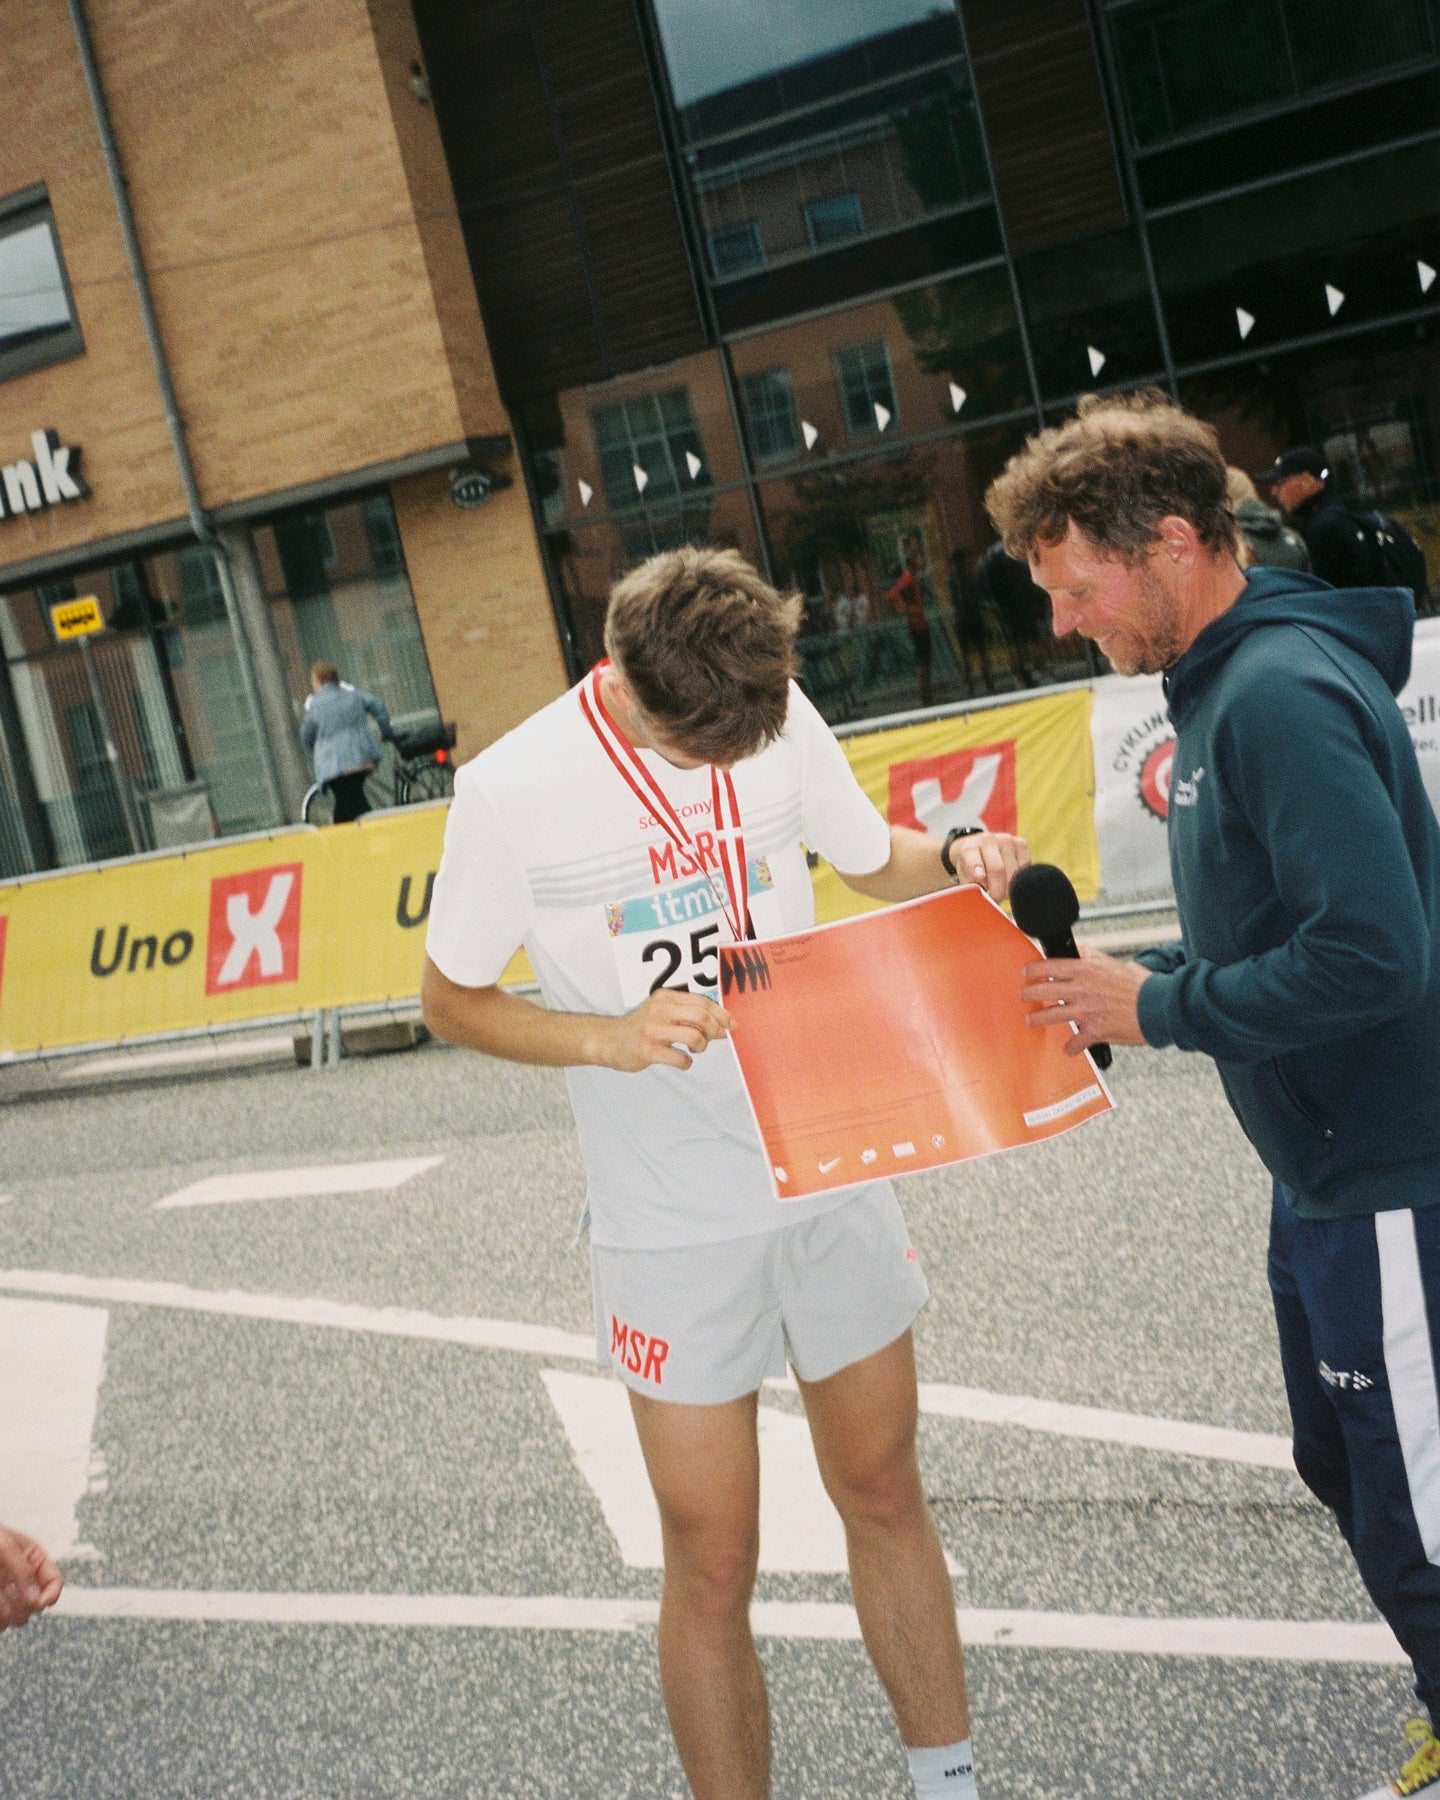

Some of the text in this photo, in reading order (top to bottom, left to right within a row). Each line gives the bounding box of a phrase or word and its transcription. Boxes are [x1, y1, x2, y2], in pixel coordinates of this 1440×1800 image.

[0, 429, 80, 518] nk
[638, 799, 713, 830] sacony
[90, 924, 193, 978] Uno
[642, 910, 756, 996] 25
[611, 1313, 669, 1385] MSR
